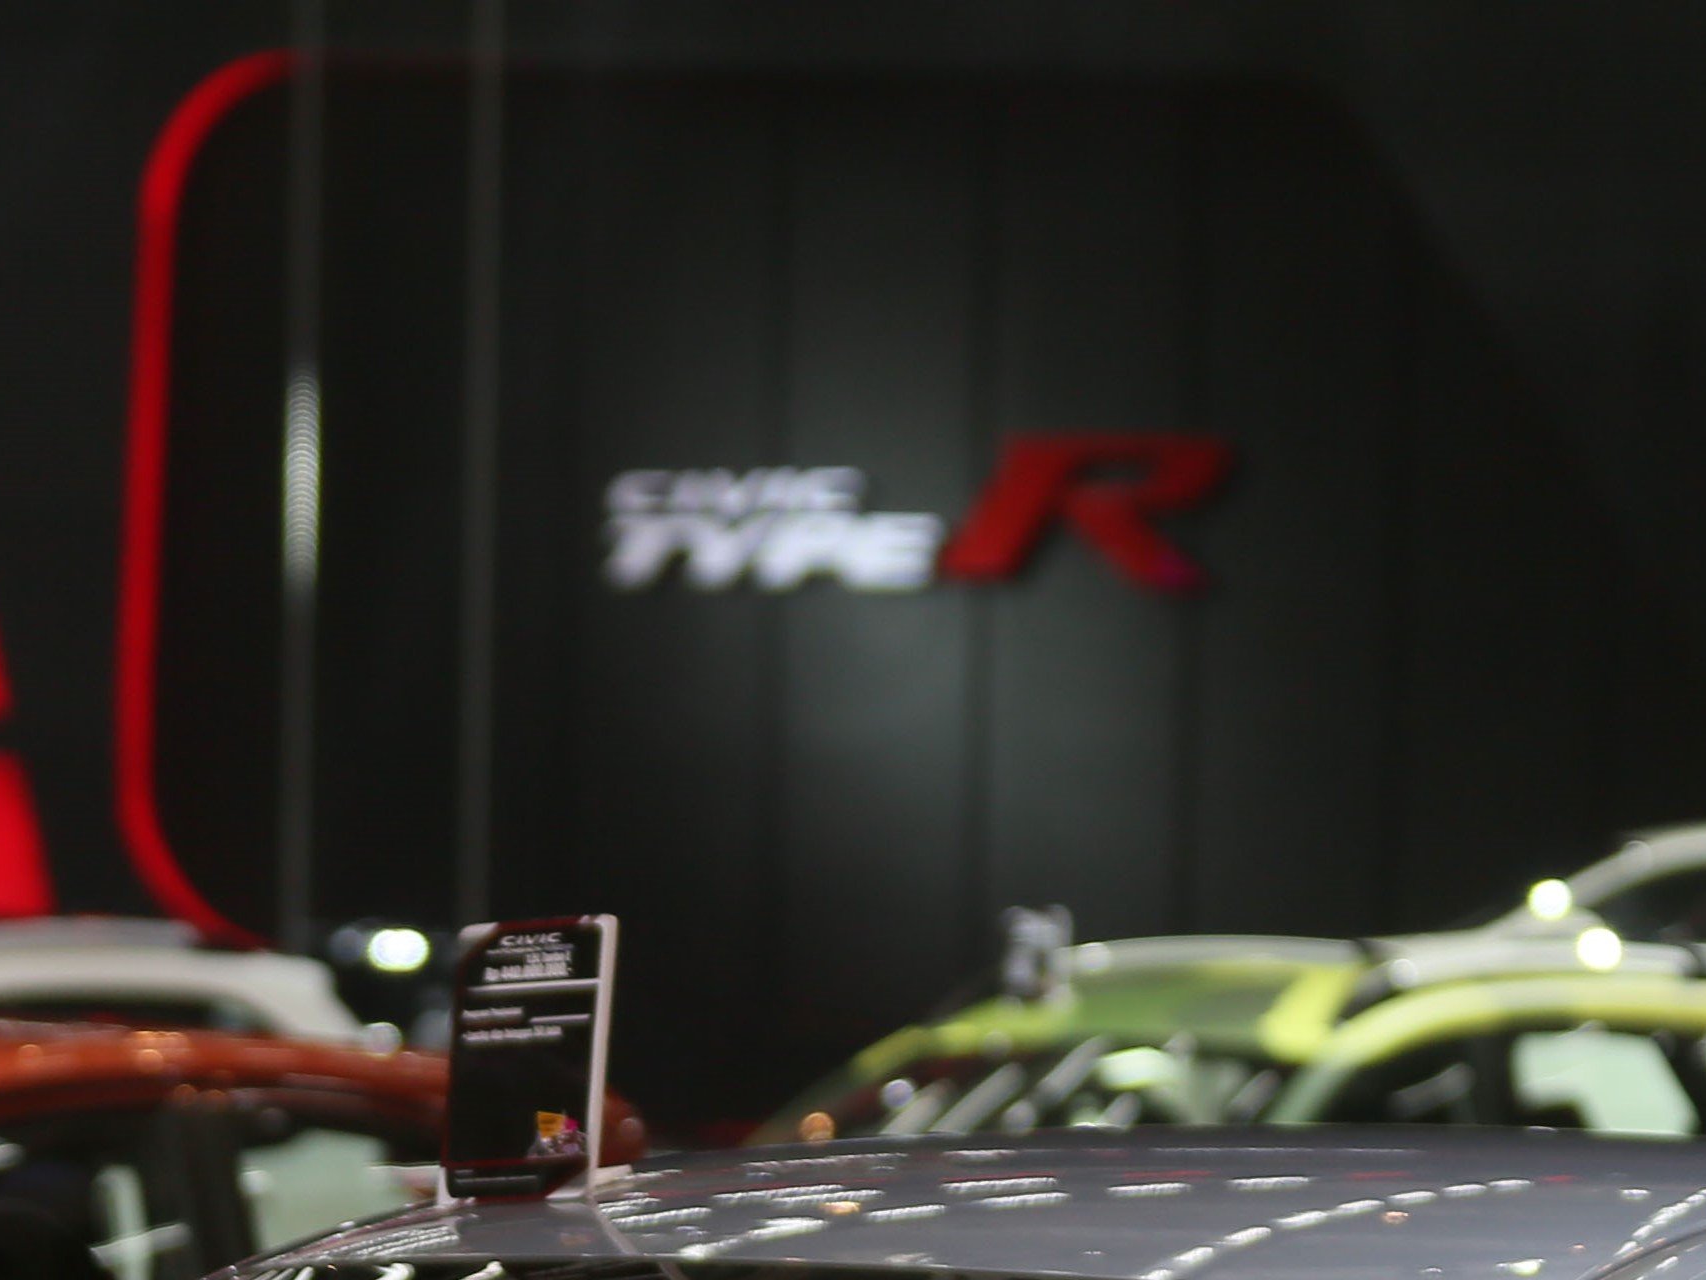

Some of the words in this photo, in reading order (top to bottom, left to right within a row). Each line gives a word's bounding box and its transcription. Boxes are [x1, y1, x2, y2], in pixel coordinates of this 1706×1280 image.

[604, 511, 944, 589] TYPE
[940, 433, 1231, 588] R
[606, 466, 867, 511] CIVIC
[499, 931, 563, 947] CIVIC
